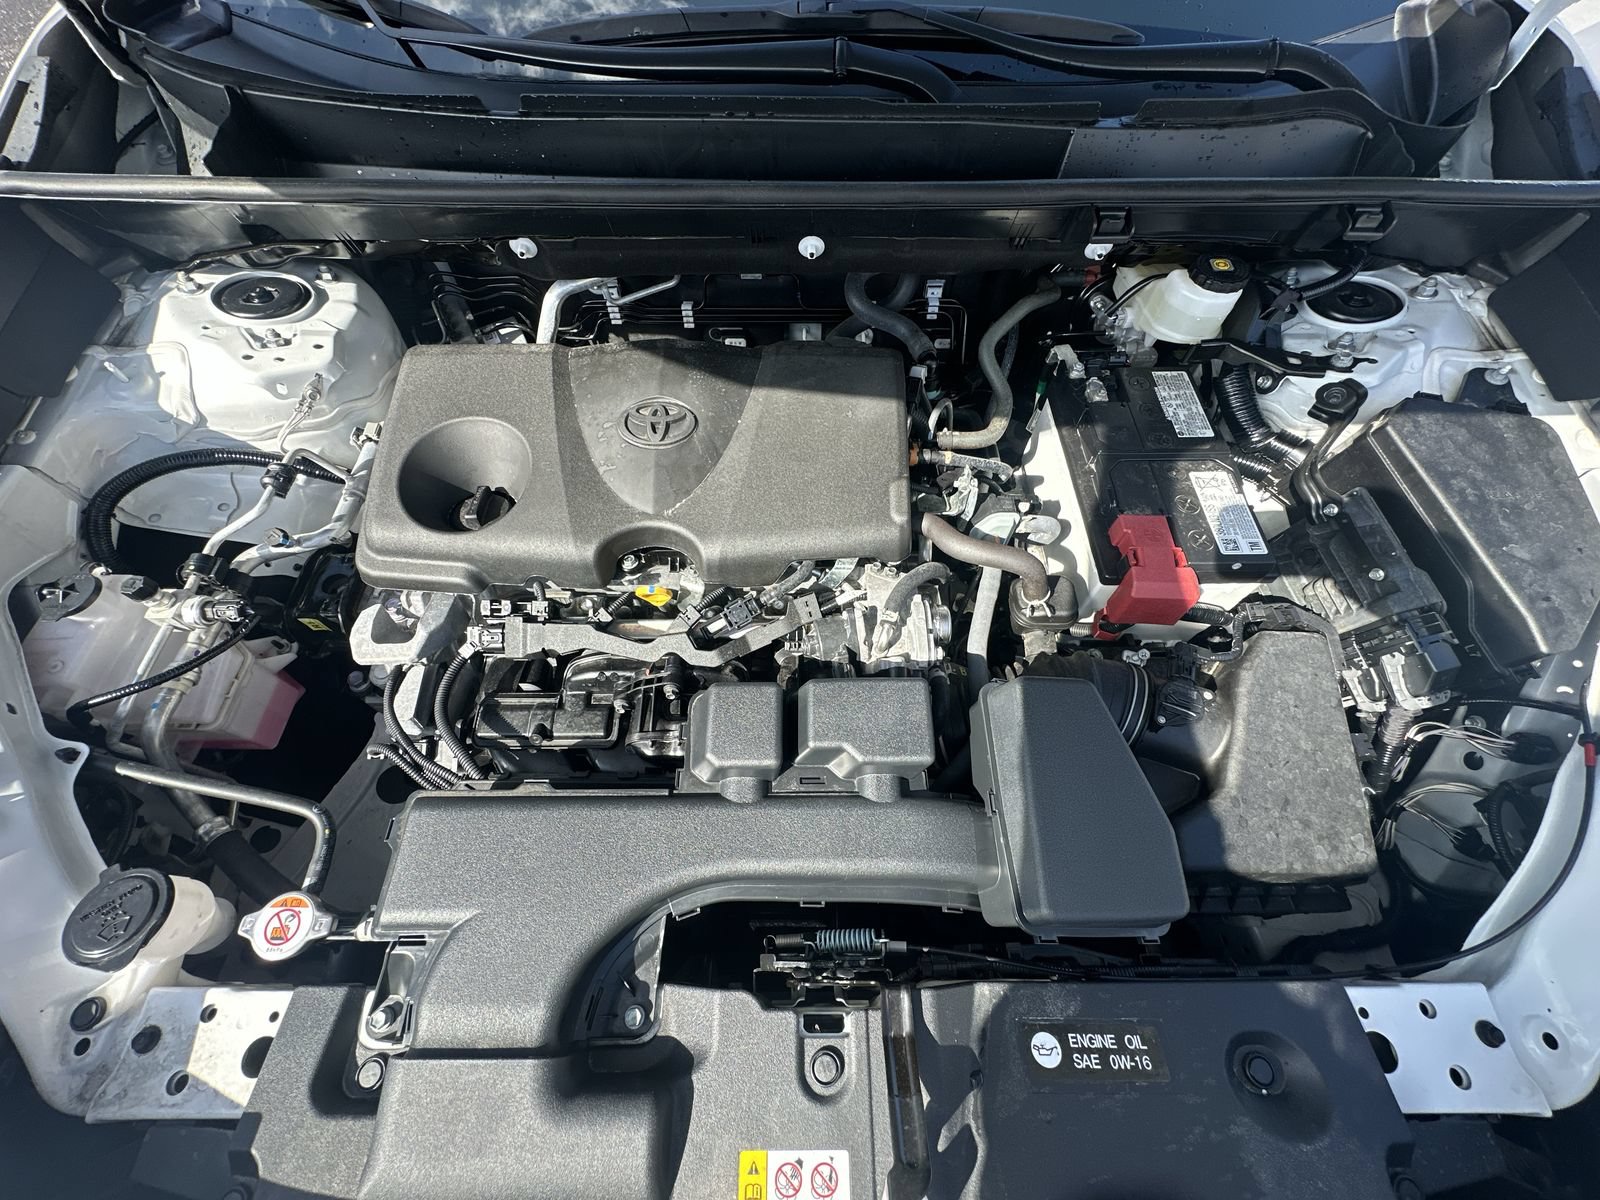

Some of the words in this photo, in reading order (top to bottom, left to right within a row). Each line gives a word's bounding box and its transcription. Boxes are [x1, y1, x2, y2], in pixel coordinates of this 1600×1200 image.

[1067, 1033, 1118, 1049] ENGINE
[1124, 1034, 1148, 1050] OIL
[1072, 1053, 1102, 1069] SAE
[1109, 1054, 1153, 1071] 0W-16
